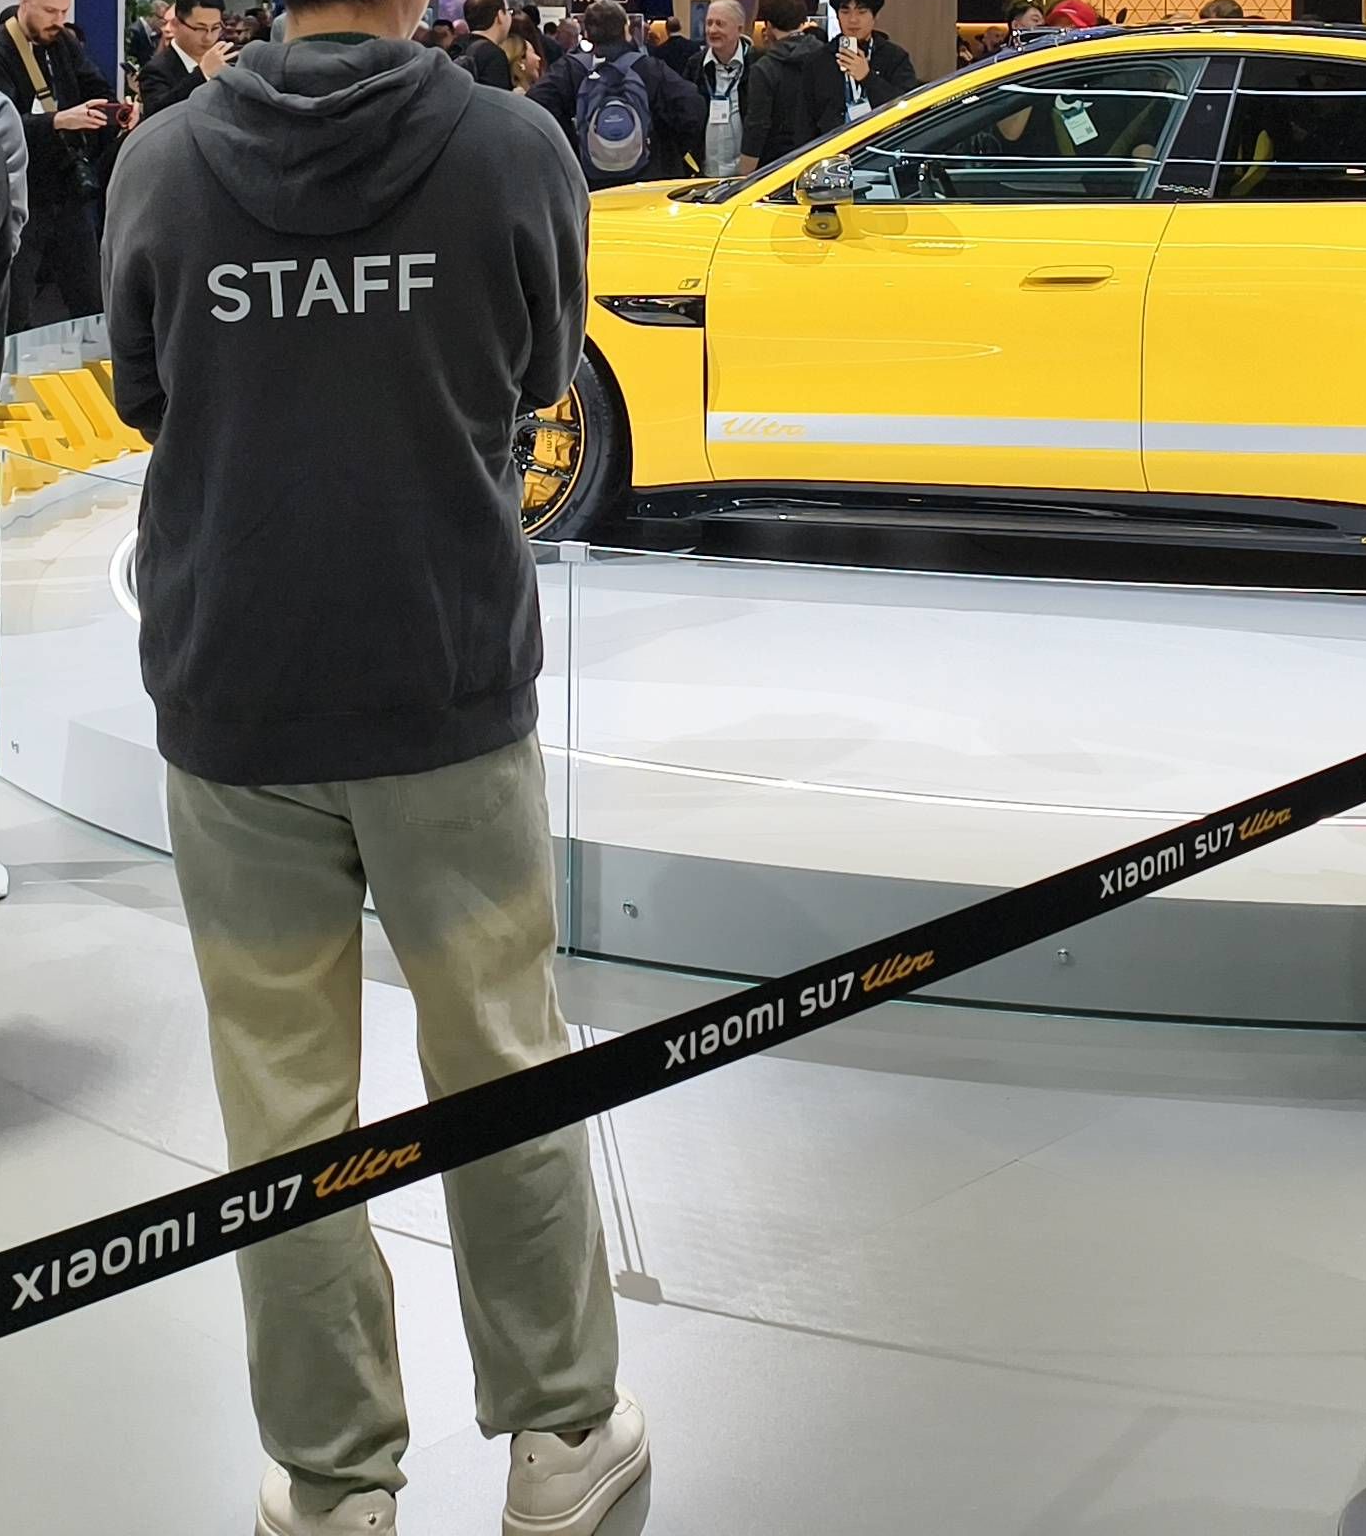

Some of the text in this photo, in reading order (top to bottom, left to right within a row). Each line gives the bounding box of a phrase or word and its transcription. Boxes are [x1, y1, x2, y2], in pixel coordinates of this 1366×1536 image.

[207, 253, 436, 323] STAFF
[1194, 822, 1234, 859] SU7
[1237, 806, 1292, 841] Ultra
[799, 971, 855, 1017] SU7
[860, 949, 935, 993] Ultra
[220, 1173, 303, 1234] SU7
[312, 1141, 422, 1199] Ultra
